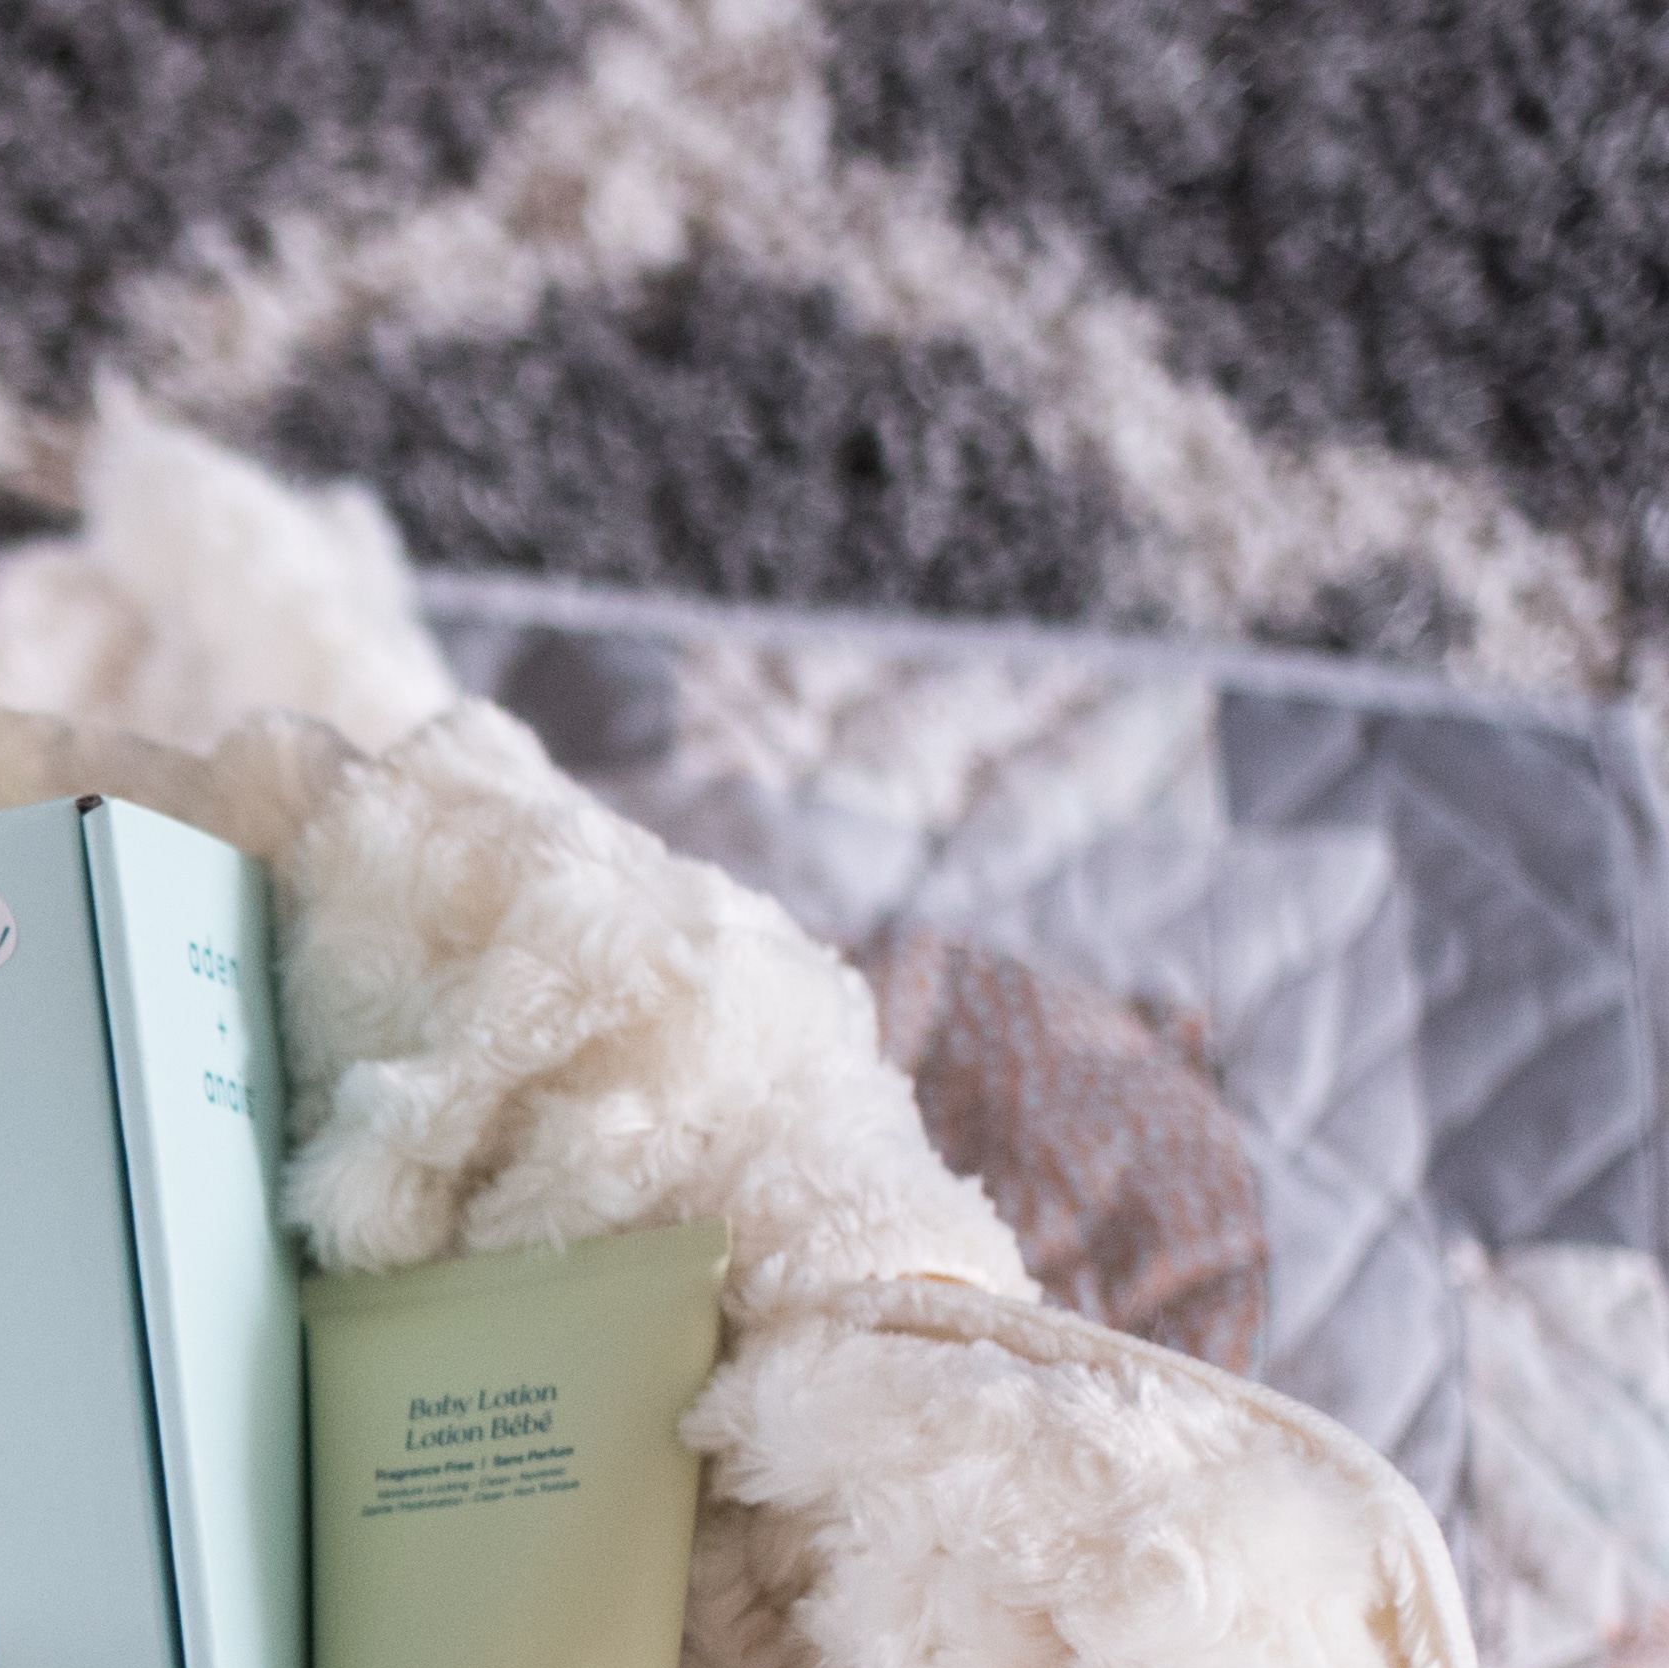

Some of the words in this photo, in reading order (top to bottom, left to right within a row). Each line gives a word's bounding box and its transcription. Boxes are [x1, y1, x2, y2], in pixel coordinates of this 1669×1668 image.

[408, 1394, 472, 1421] Baby
[478, 1385, 558, 1411] Lotion
[405, 1425, 483, 1450] Lotion
